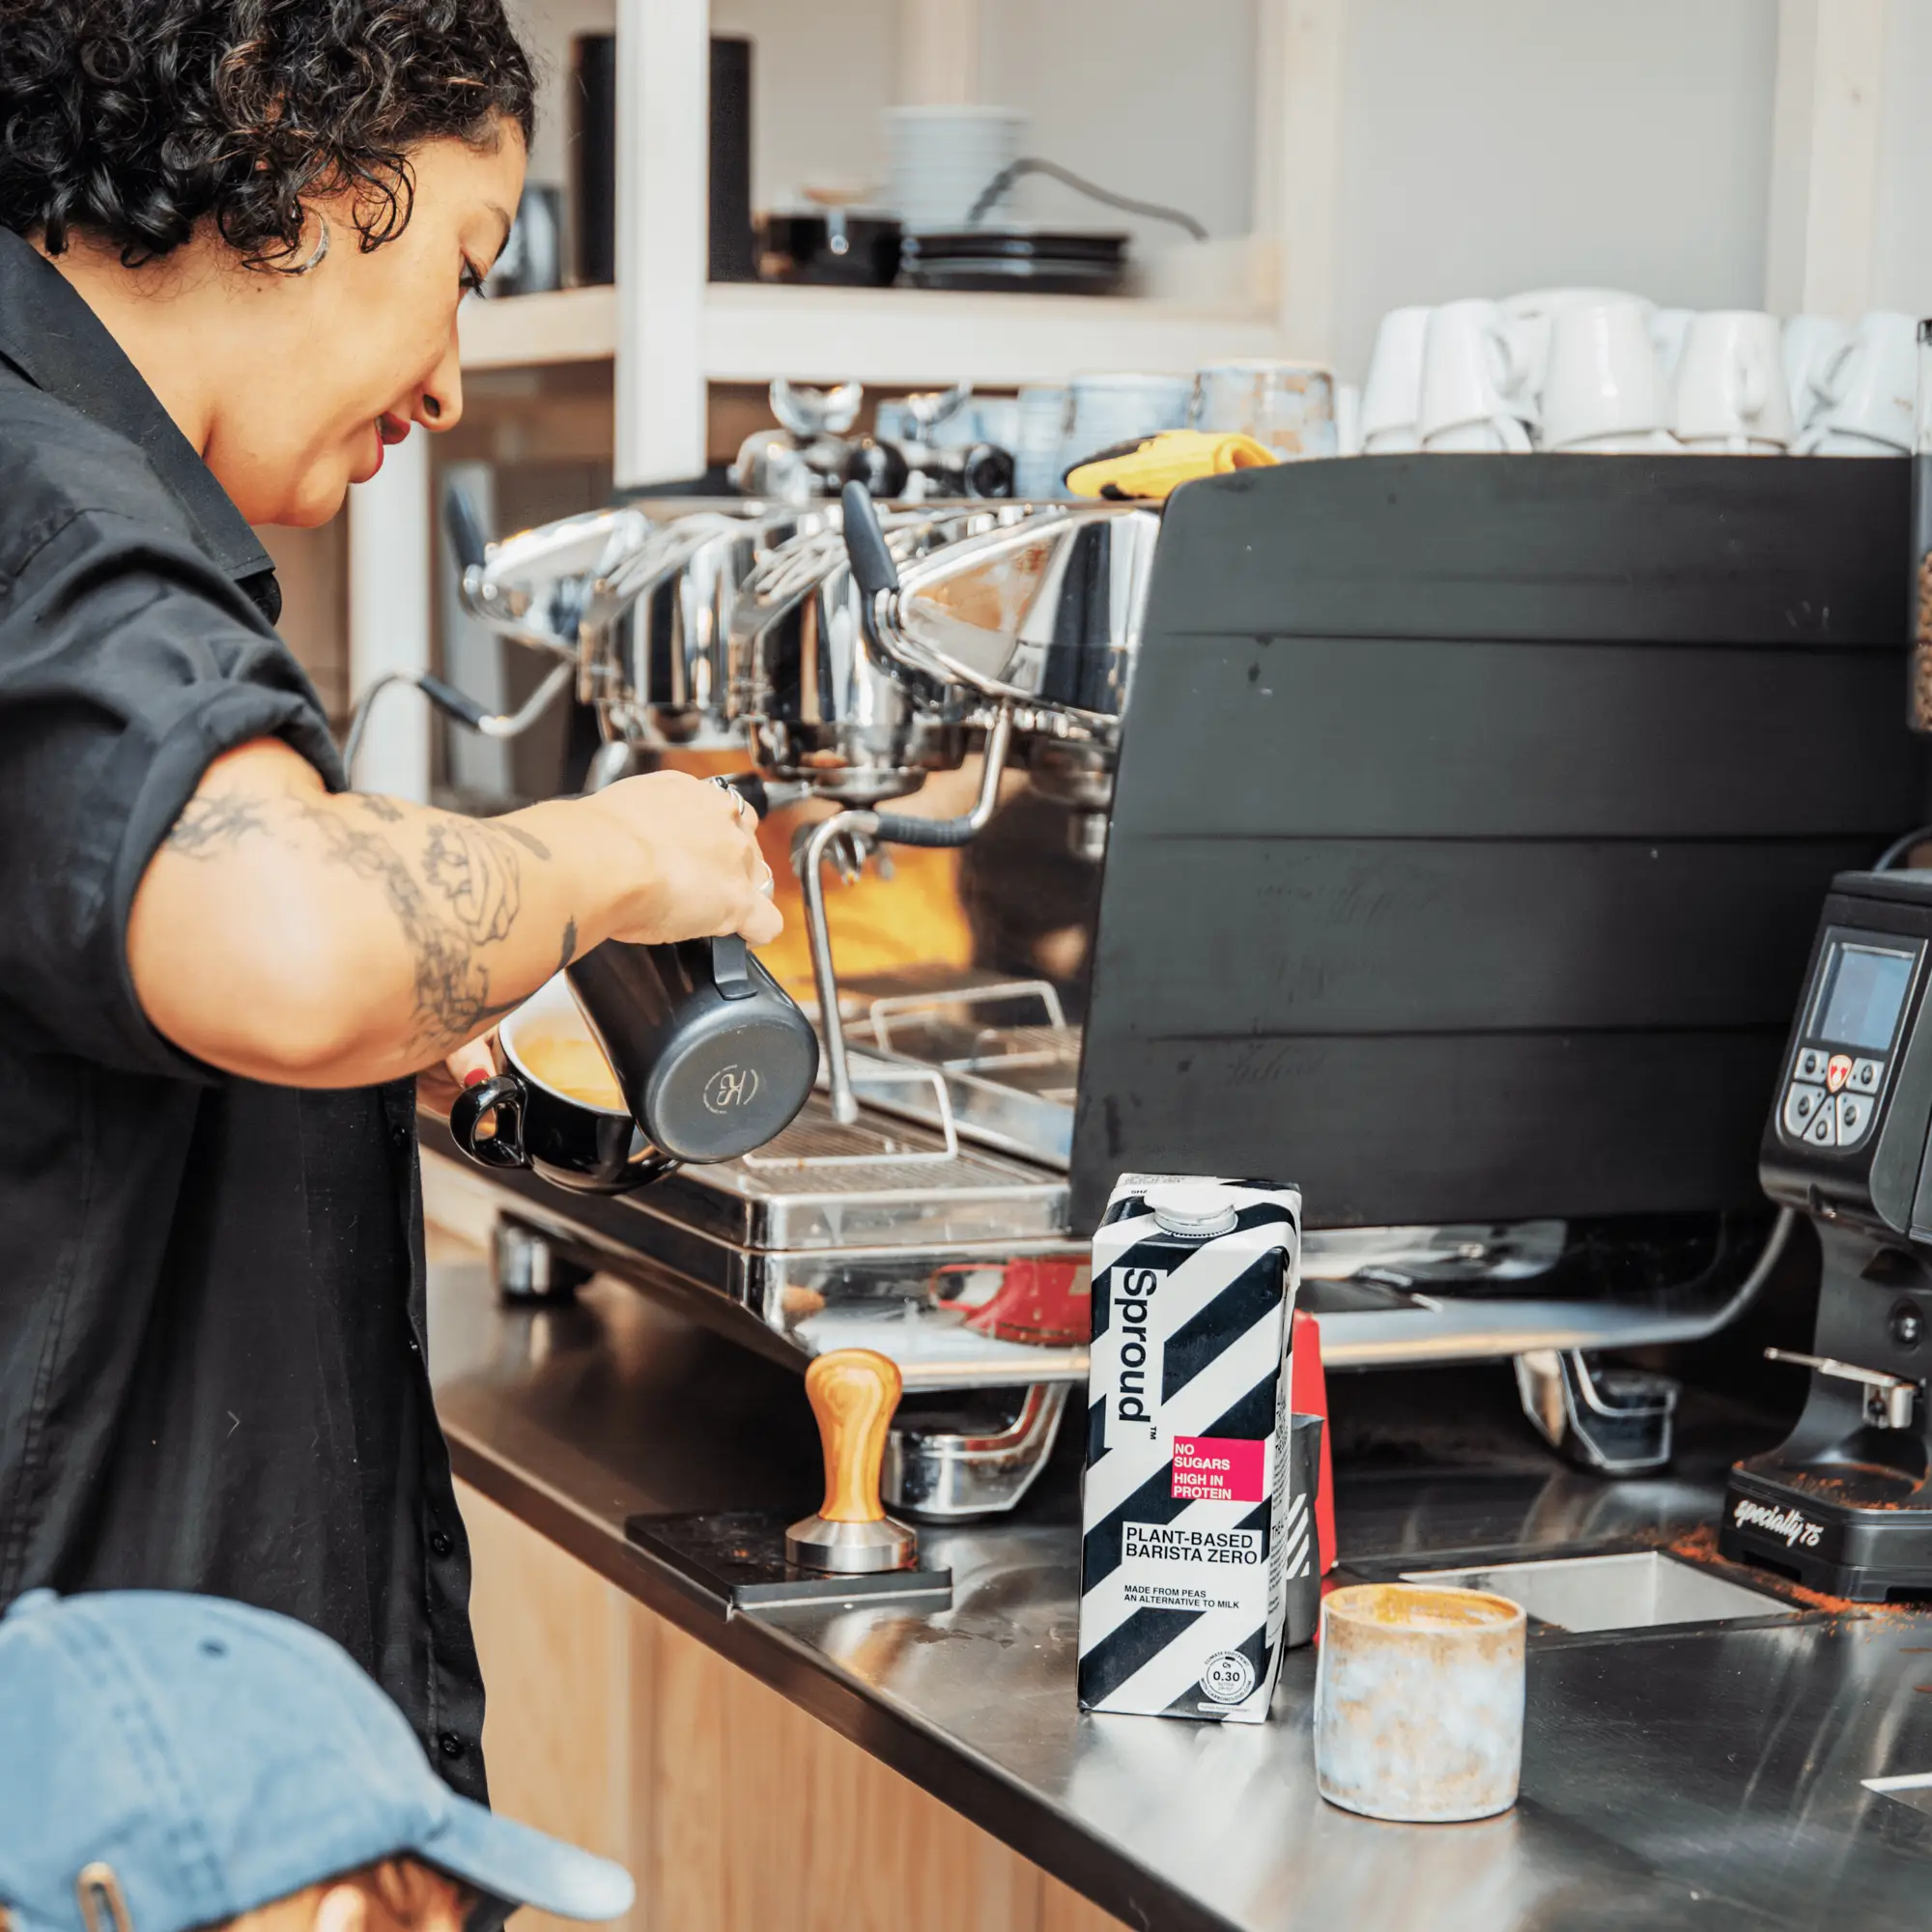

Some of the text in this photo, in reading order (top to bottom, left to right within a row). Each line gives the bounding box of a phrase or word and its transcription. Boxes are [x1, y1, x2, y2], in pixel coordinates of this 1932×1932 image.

[1114, 1268, 1157, 1423] Sproud
[1174, 1443, 1195, 1456] NO
[1174, 1457, 1231, 1470] SUGARS
[1174, 1472, 1224, 1487] HIGH IN
[1173, 1486, 1232, 1500] PROTEIN
[1126, 1526, 1253, 1548] PLANT-BASED
[1125, 1543, 1257, 1565] BARISTA ZERO
[1123, 1584, 1207, 1598] MADE FROM PEAS
[1139, 1595, 1200, 1607] ALTERNATIVE
[1203, 1599, 1215, 1608] TO
[1217, 1600, 1240, 1609] MILK
[1212, 1670, 1240, 1683] 0.30
